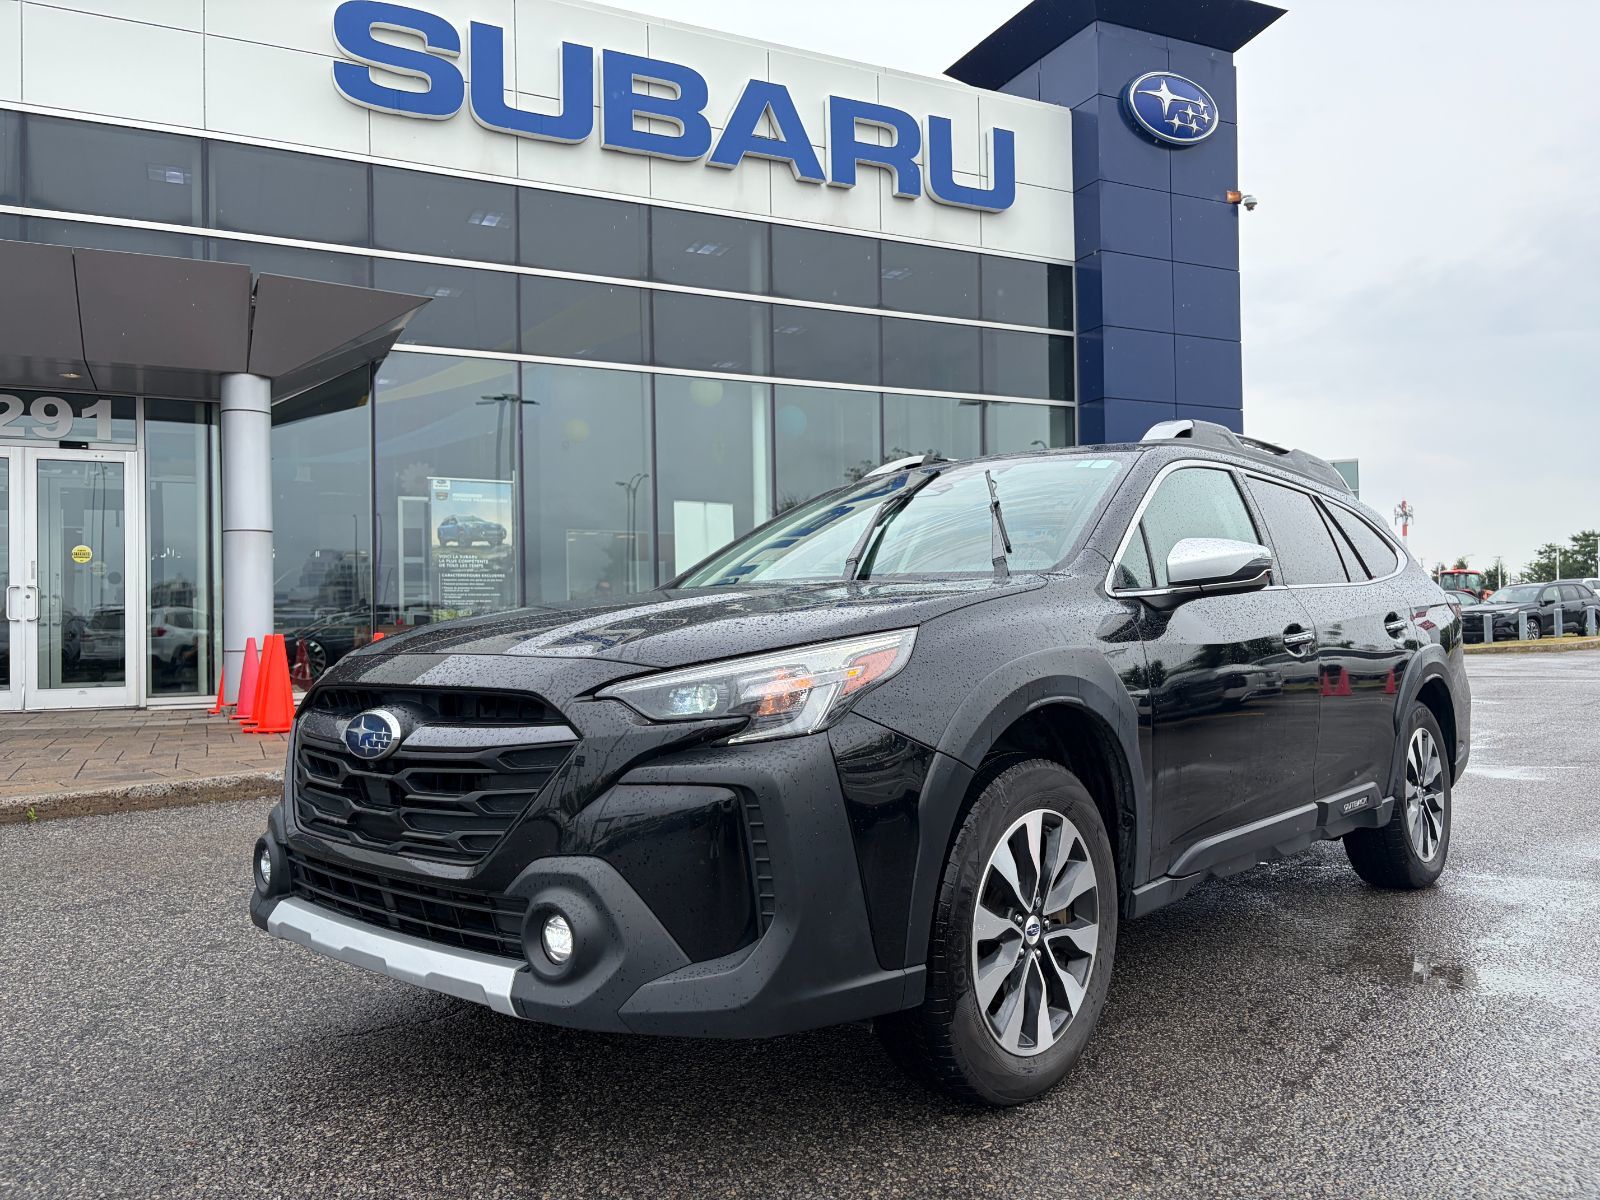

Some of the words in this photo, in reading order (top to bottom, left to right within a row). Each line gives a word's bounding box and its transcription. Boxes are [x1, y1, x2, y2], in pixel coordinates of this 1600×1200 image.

[331, 0, 1016, 214] SUBARU
[0, 393, 112, 441] 291
[1343, 797, 1368, 810] OUTBACK
